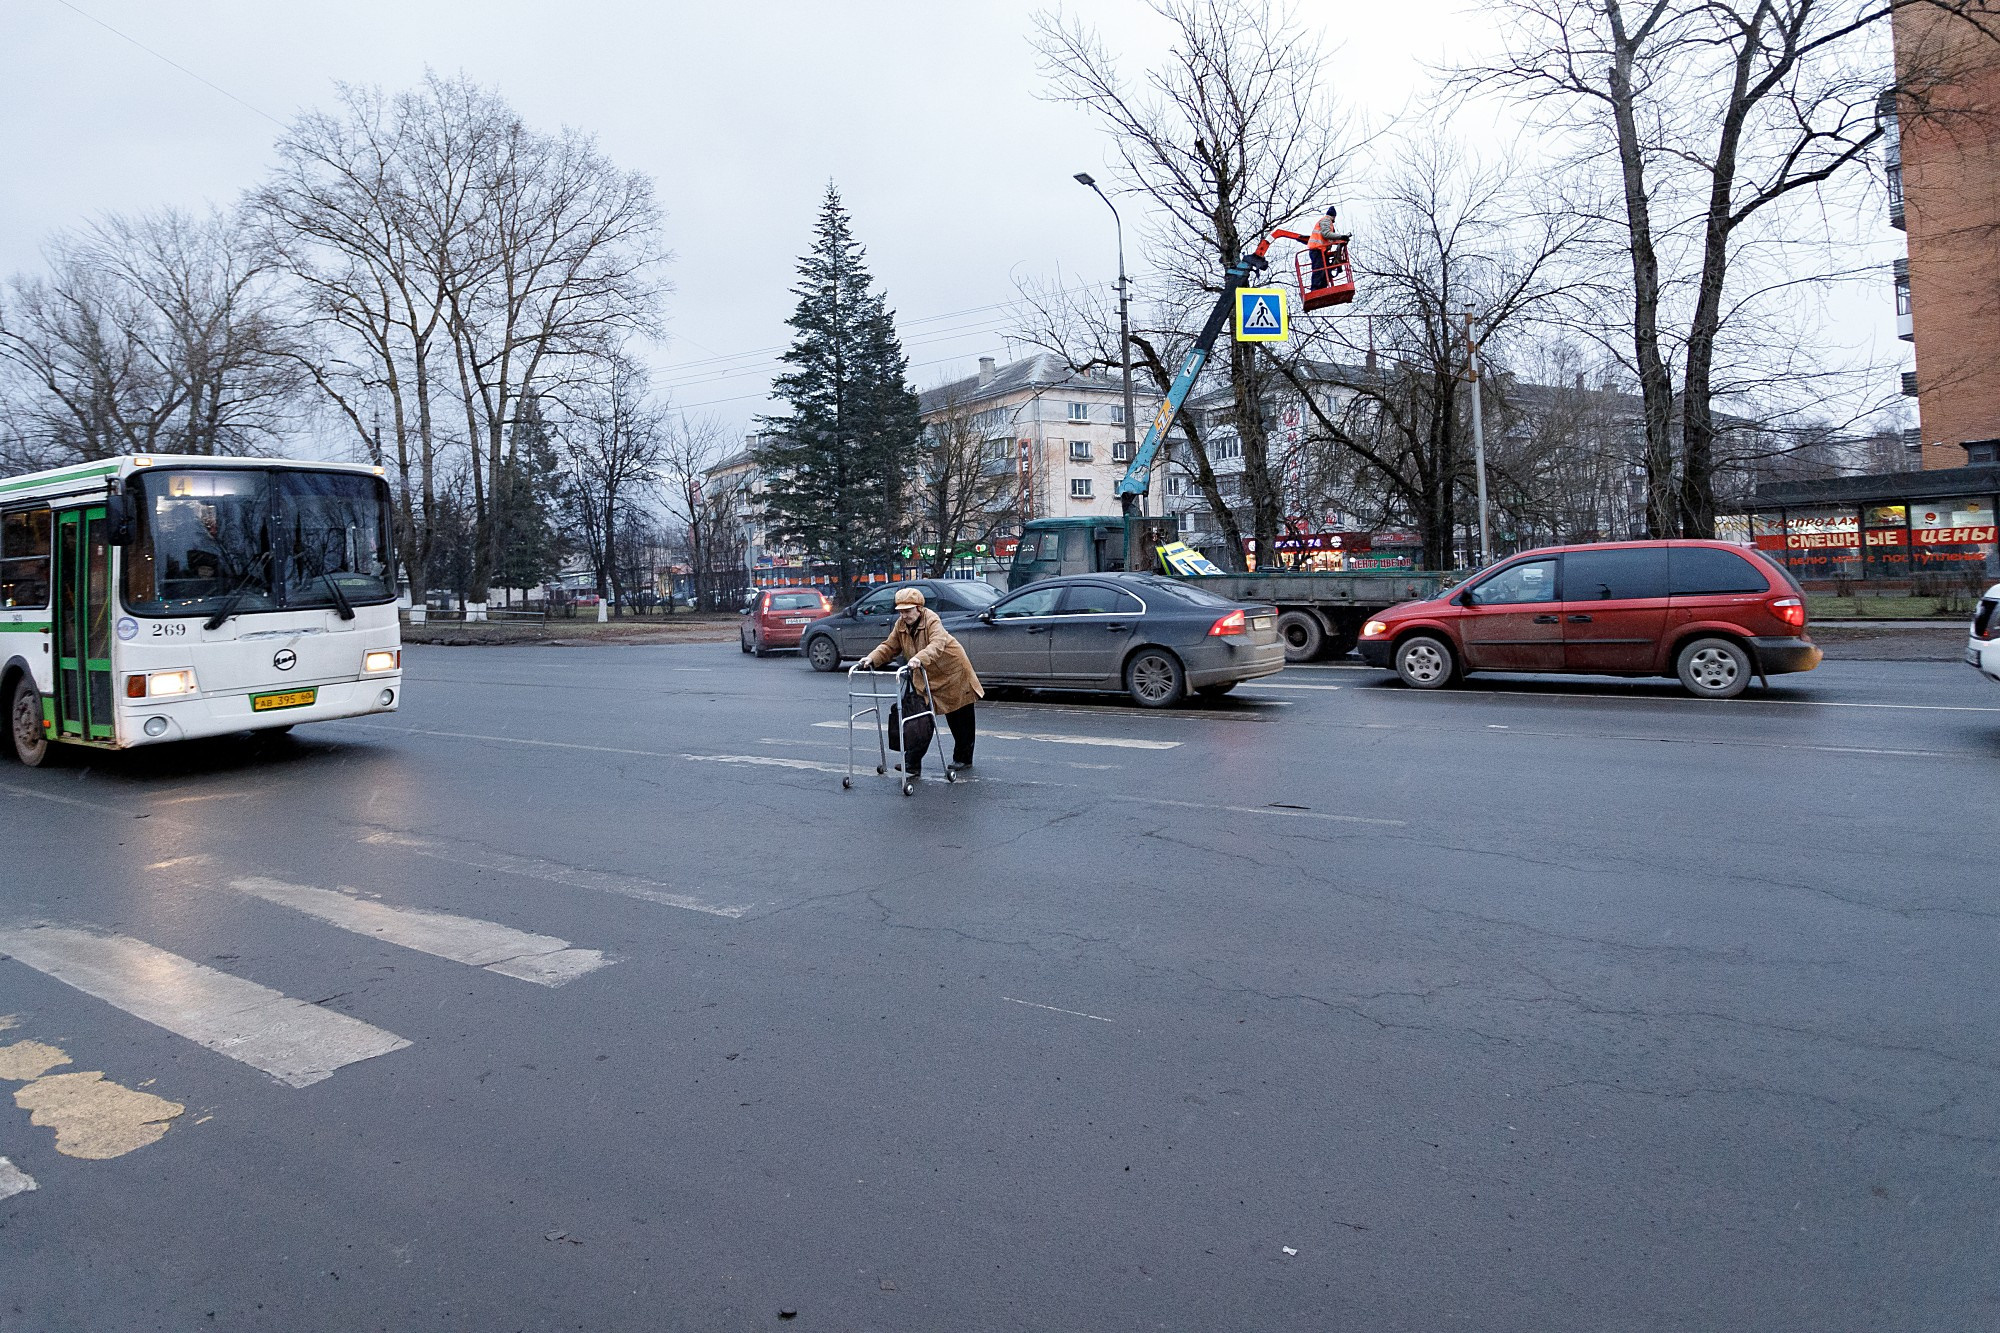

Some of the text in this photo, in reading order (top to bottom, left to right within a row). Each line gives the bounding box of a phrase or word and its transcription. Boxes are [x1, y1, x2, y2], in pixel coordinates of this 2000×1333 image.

[1787, 527, 1995, 549] СМЕШНЫЕ ЦЕНЫ
[1005, 543, 1035, 552] АПТКА
[1351, 557, 1412, 570] ЦЕНТР ЦВЕТОВ
[152, 623, 186, 637] 269
[277, 694, 296, 706] 395
